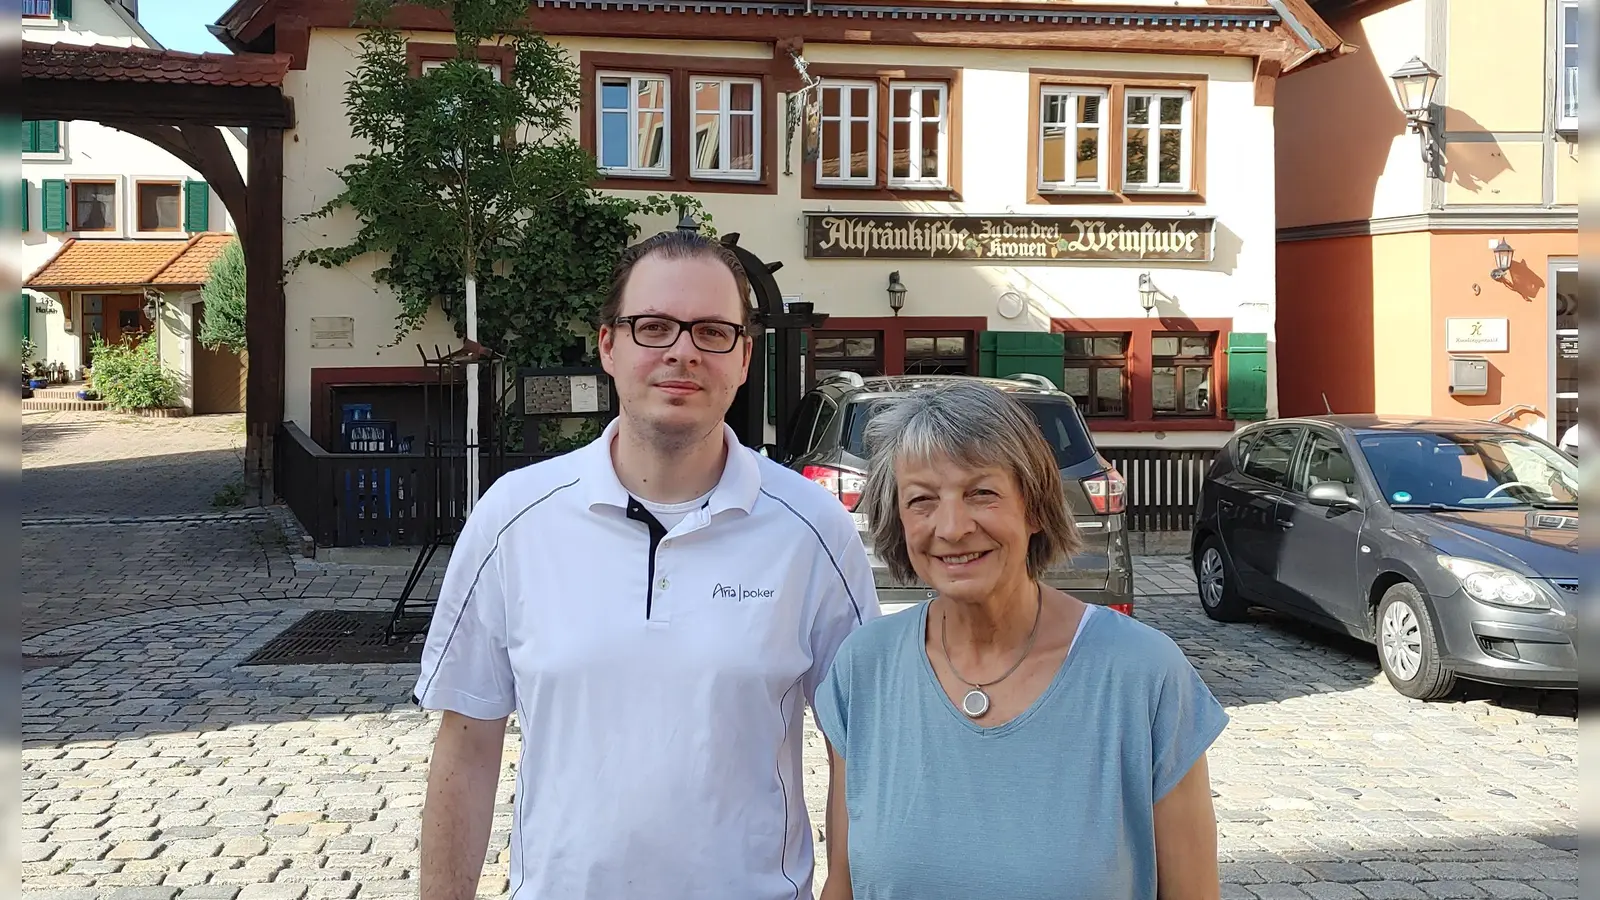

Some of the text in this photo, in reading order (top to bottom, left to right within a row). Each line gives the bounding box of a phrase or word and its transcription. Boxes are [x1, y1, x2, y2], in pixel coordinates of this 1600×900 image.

[819, 216, 970, 257] Altfränkische
[979, 219, 1059, 239] Zu den drei
[986, 238, 1047, 257] Kronen
[1068, 219, 1199, 259] Weinstube
[1471, 282, 1481, 296] 9
[743, 588, 775, 599] poker
